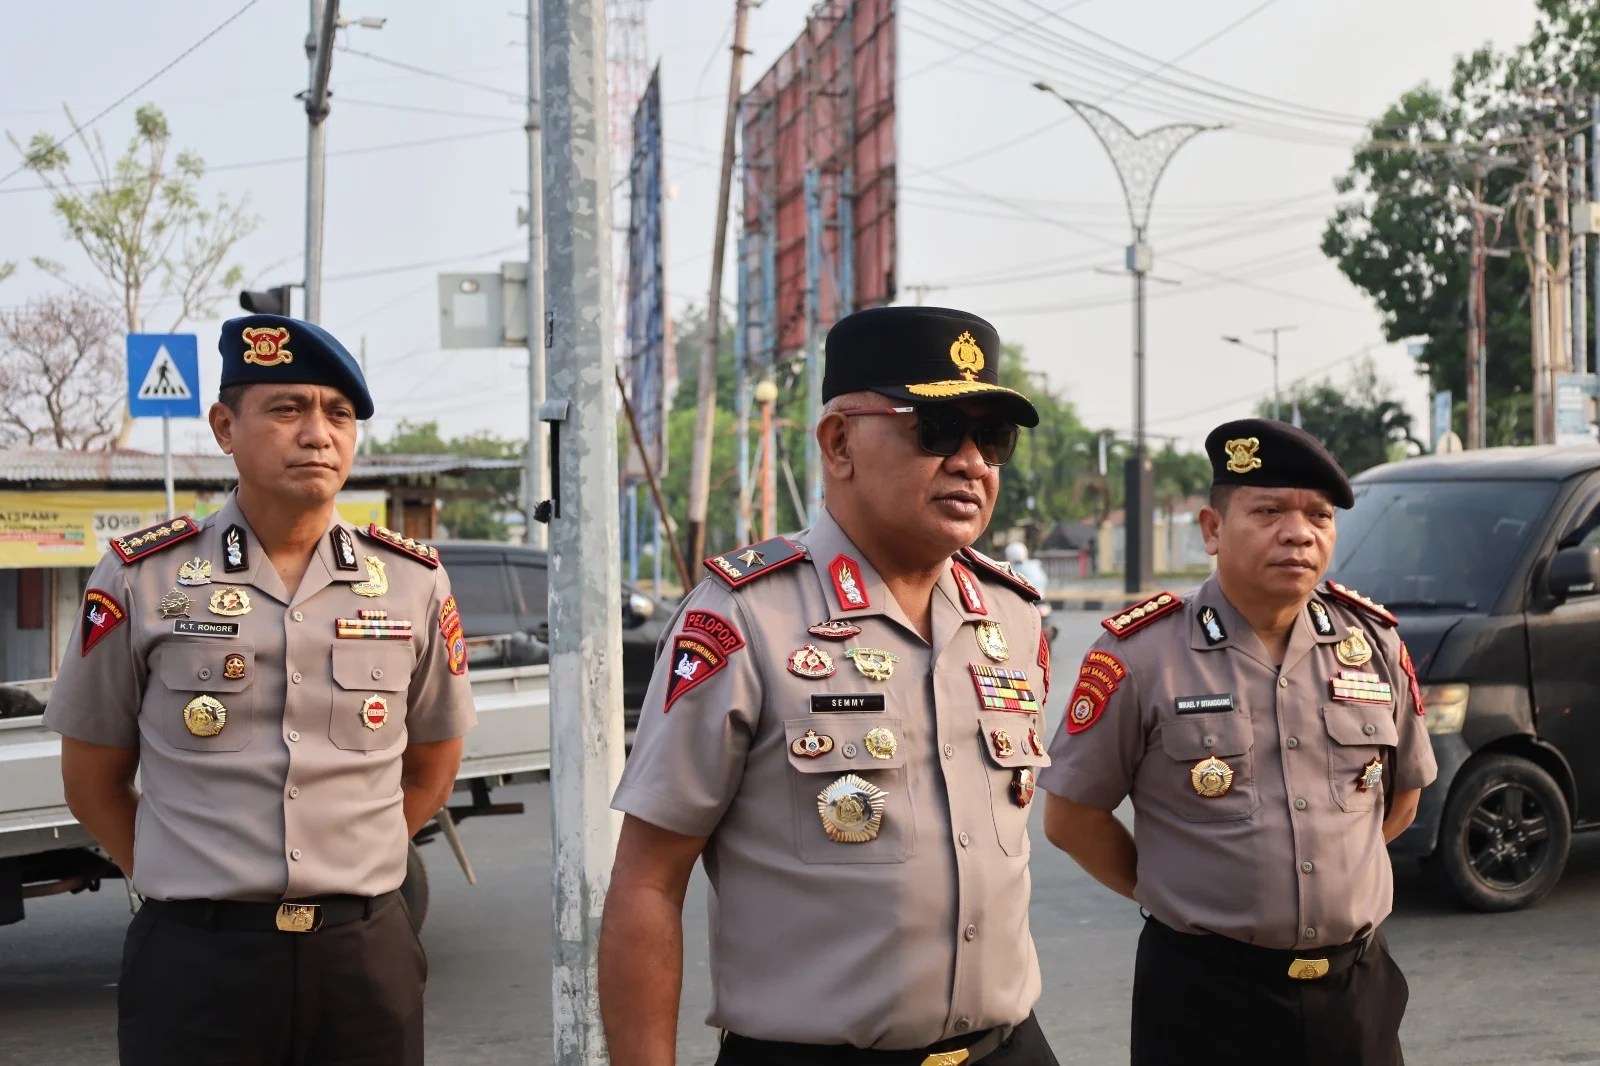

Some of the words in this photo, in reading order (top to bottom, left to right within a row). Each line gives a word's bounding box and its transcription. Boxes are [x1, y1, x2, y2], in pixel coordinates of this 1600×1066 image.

[115, 537, 135, 556] POLISI
[713, 556, 742, 580] POLISI
[180, 622, 195, 631] K.T.
[197, 624, 233, 632] RONGRE
[687, 614, 737, 650] PELOPOR
[696, 644, 718, 665] BRIMOB
[1089, 652, 1123, 677] BAHARKAM
[1090, 667, 1114, 690] SAMAPTA
[831, 698, 865, 707] SEMMY
